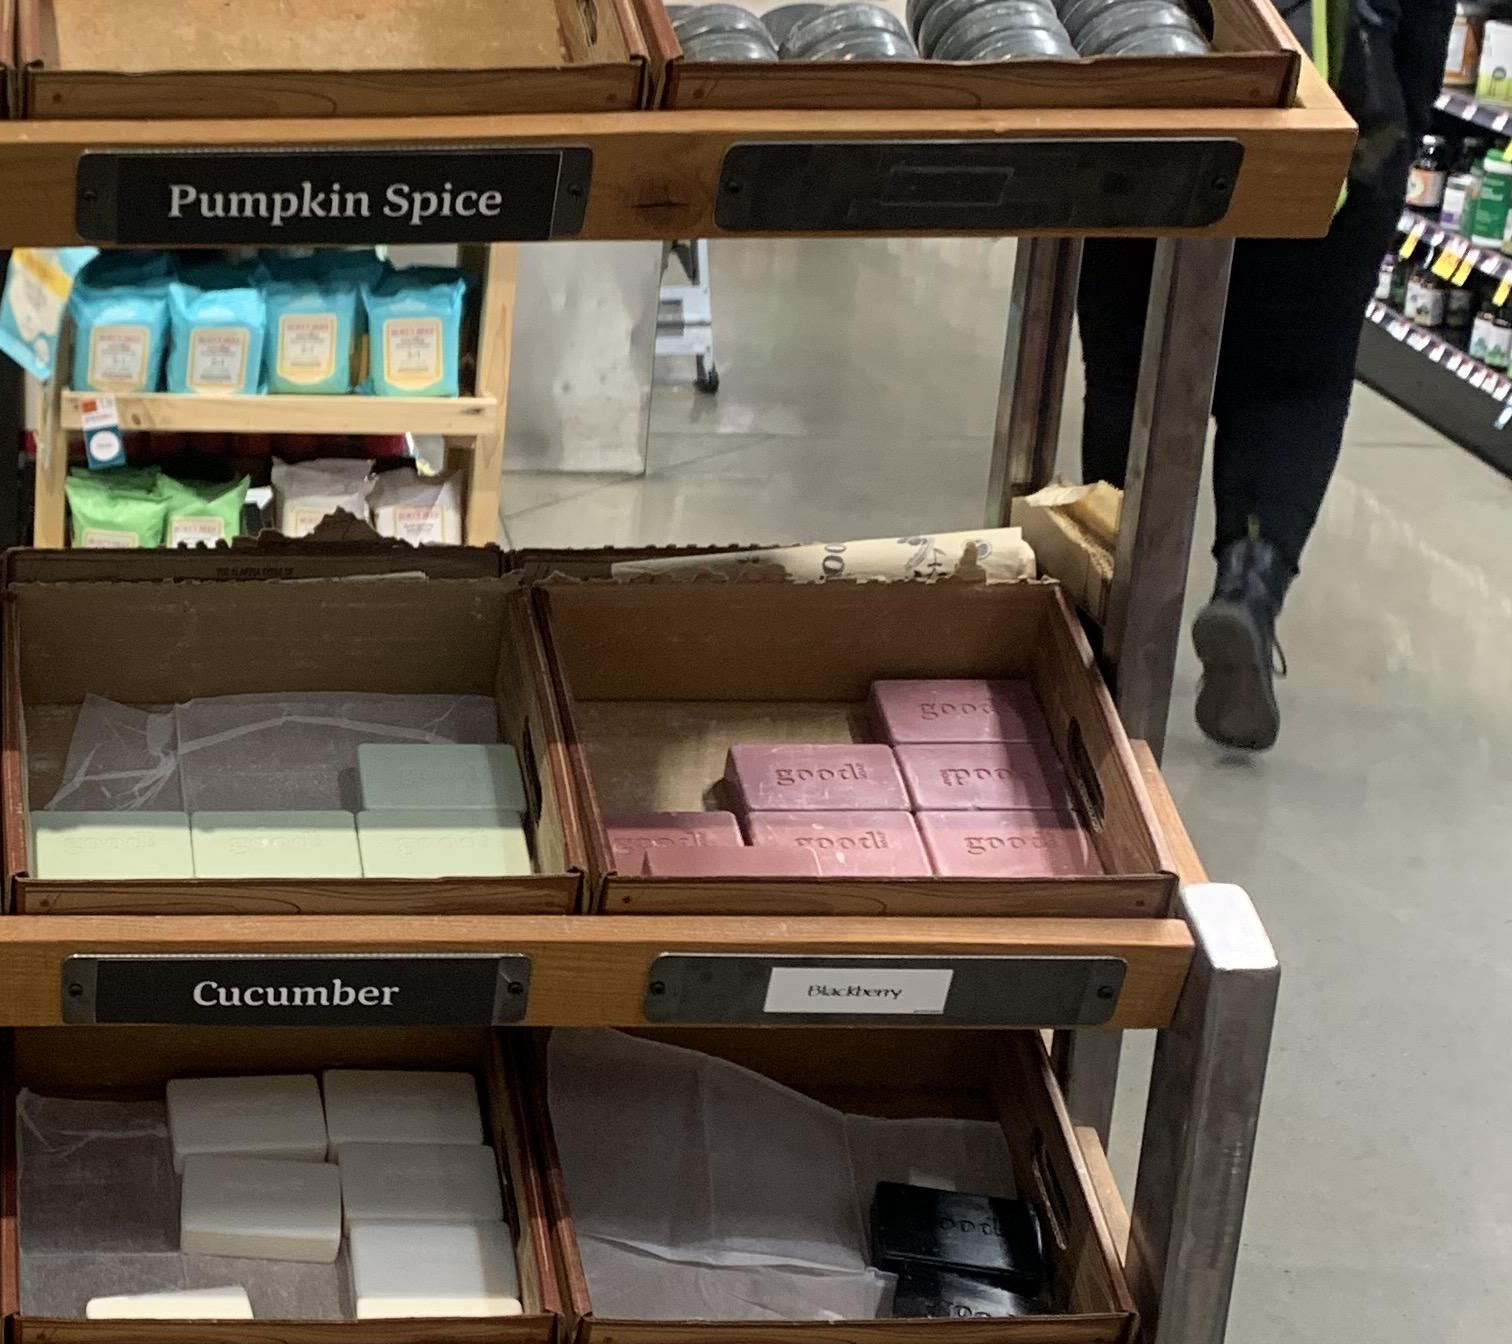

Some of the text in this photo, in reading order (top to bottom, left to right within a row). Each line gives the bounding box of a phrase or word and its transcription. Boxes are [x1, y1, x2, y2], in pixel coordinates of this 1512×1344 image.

[168, 181, 503, 226] Pumpkin Spice
[775, 762, 859, 787] good
[192, 977, 400, 1006] Cucumber
